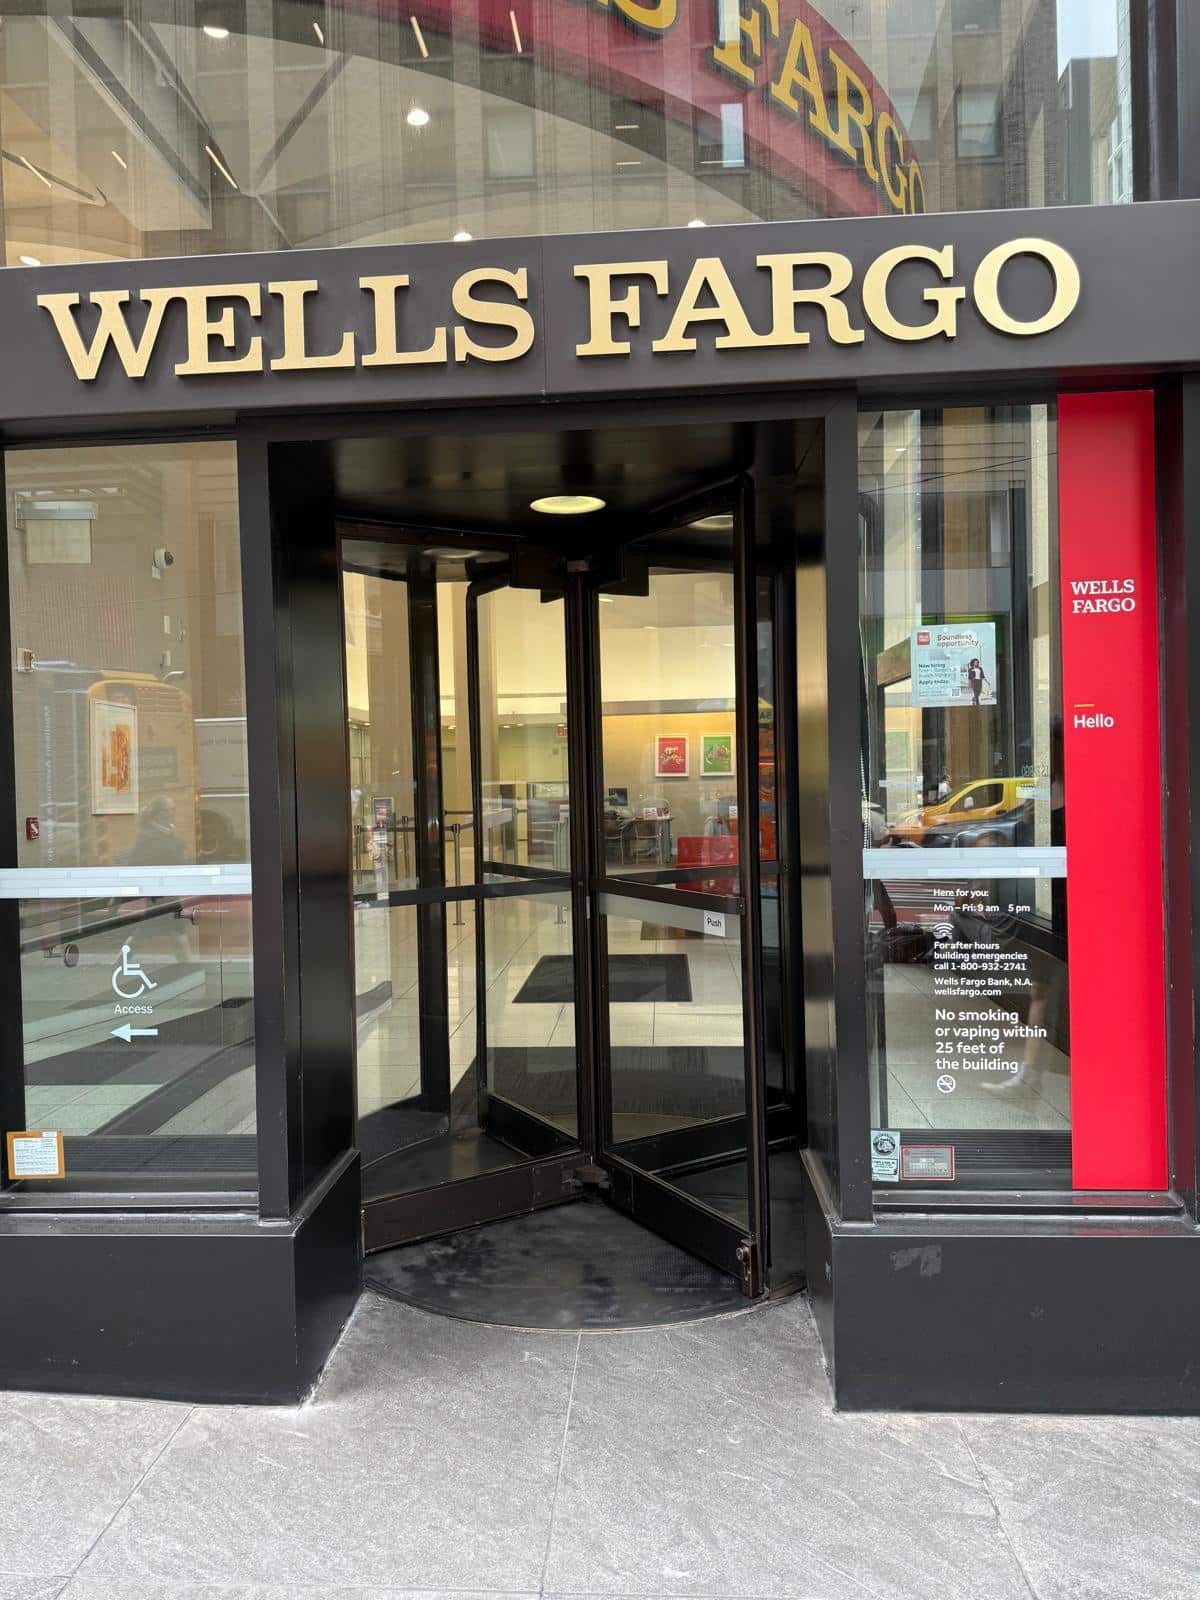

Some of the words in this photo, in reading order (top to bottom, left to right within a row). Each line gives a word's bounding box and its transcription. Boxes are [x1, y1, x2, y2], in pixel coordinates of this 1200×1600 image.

[37, 266, 535, 381] WELLS
[573, 237, 1081, 357] FARGO
[1070, 579, 1135, 595] WELLS
[1072, 598, 1136, 614] FARGO
[937, 634, 973, 642] Boundless
[937, 640, 980, 649] opportunity
[1073, 713, 1114, 729] Hello
[933, 888, 954, 897] Here
[955, 888, 969, 897] for
[970, 889, 989, 898] you:
[933, 904, 953, 912] Mon
[962, 903, 976, 912] Fri:
[977, 904, 983, 912] 9
[1008, 904, 1014, 912] 5
[1016, 905, 1031, 913] pm
[707, 916, 722, 928] Push
[934, 941, 949, 949] For
[950, 941, 972, 949] after
[974, 941, 1000, 950] hours
[934, 952, 970, 961] building
[971, 952, 1028, 962] emergencies
[934, 962, 949, 970] call
[951, 962, 1027, 971] 1-800-932-2741
[934, 977, 959, 986] Wells
[960, 977, 986, 988] Fargo
[988, 978, 1012, 987] Bank,
[1014, 978, 1033, 986] N.A.
[934, 987, 1002, 998] wellsfargo.com
[113, 1004, 153, 1015] Access
[935, 1009, 955, 1021] No
[959, 1009, 1019, 1024] smoking
[935, 1027, 950, 1037] or
[953, 1025, 1000, 1040] vaping
[1002, 1026, 1047, 1038] within
[935, 1042, 954, 1054] 25
[957, 1042, 986, 1054] feet
[989, 1042, 1005, 1054] of
[935, 1058, 959, 1070] the
[962, 1058, 1018, 1073] building
